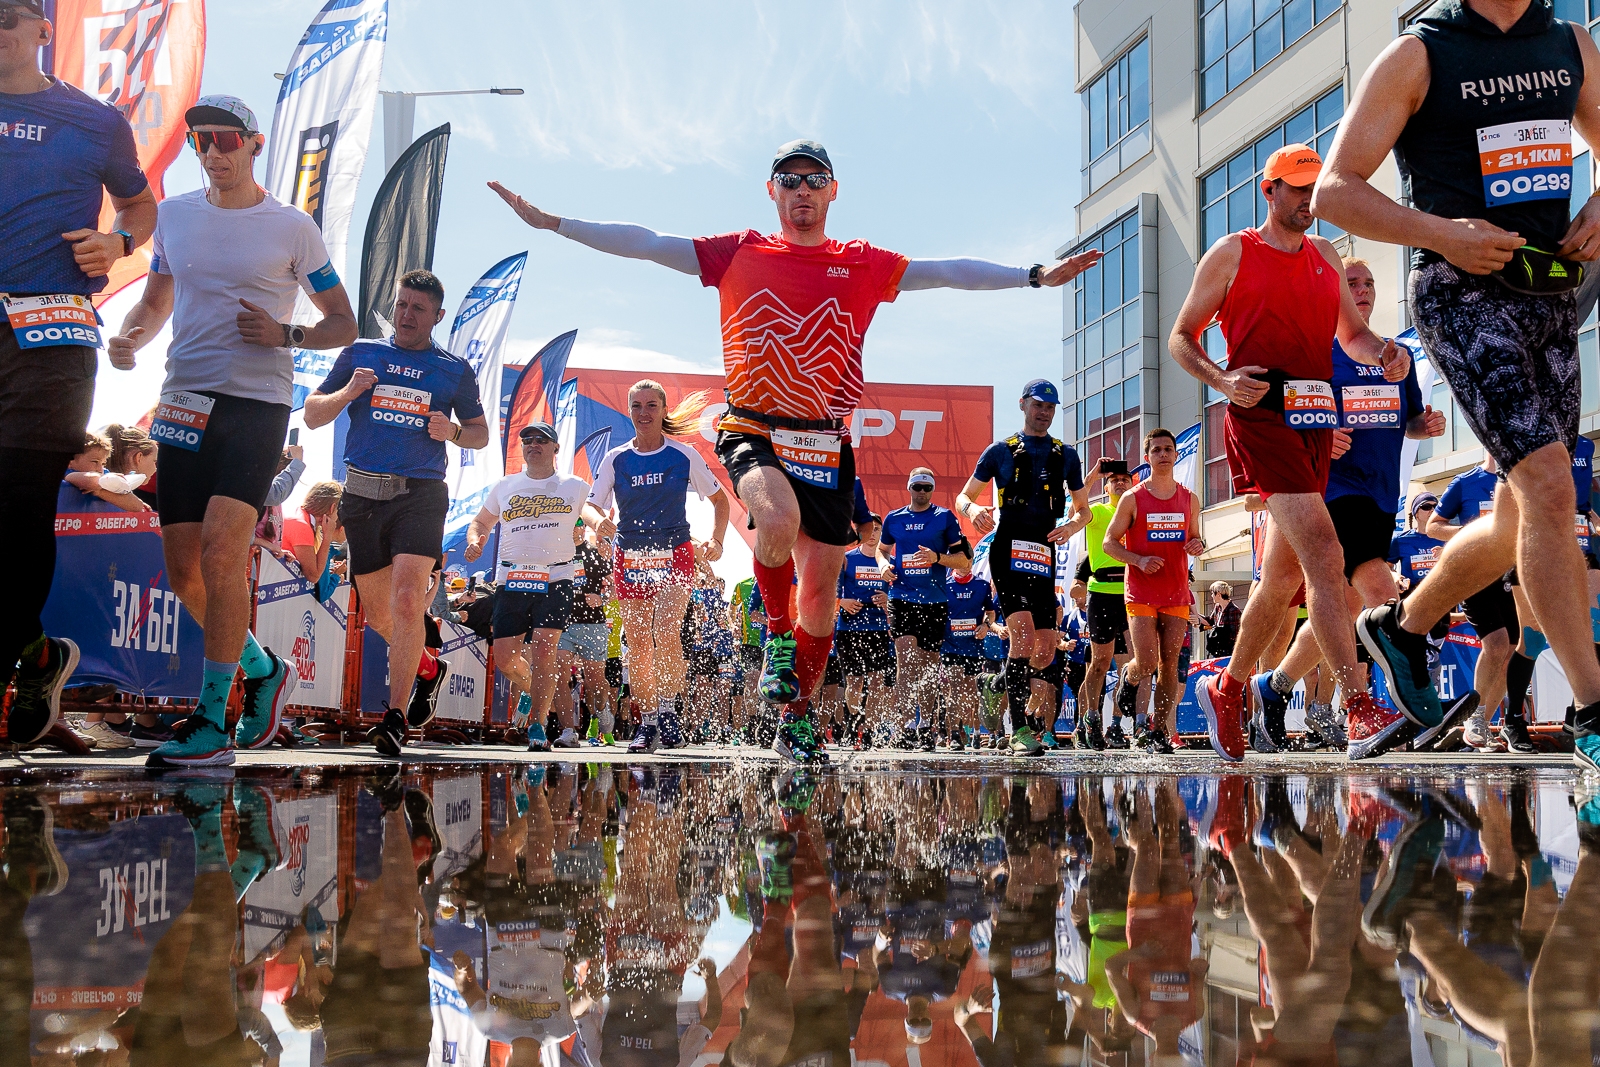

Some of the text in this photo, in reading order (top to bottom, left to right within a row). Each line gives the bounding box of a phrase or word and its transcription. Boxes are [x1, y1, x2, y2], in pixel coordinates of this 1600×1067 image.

[1460, 69, 1571, 100] RUNNING
[1482, 89, 1559, 106] SPORT
[14, 123, 47, 142] БЕГ
[1518, 127, 1547, 142] ЗА БЕГ
[1490, 173, 1570, 198] 00293
[826, 266, 849, 275] ALTAI
[39, 294, 70, 306] ЗА БЕГ
[25, 326, 98, 343] 00125
[386, 363, 424, 380] ЗА БЕГ
[1355, 365, 1371, 376] ЗА
[1306, 384, 1315, 393] ЗА
[372, 410, 425, 428] 00076
[699, 402, 943, 451] СРТ
[1289, 412, 1338, 425] 00010
[1346, 413, 1398, 424] 00369
[151, 423, 199, 445] 00240
[793, 436, 818, 447] ЗА БЕГ
[631, 472, 664, 487] ЗА БЕГ
[95, 517, 138, 530] ЗАБЕГ.РФ
[511, 525, 529, 533] БЕГИ
[1014, 561, 1049, 574] 00391
[508, 581, 546, 591] 00016
[110, 579, 185, 655] ЗА БЕГ
[291, 637, 310, 660] АВТО
[296, 659, 316, 682] РАДИО
[454, 673, 475, 699] MAER
